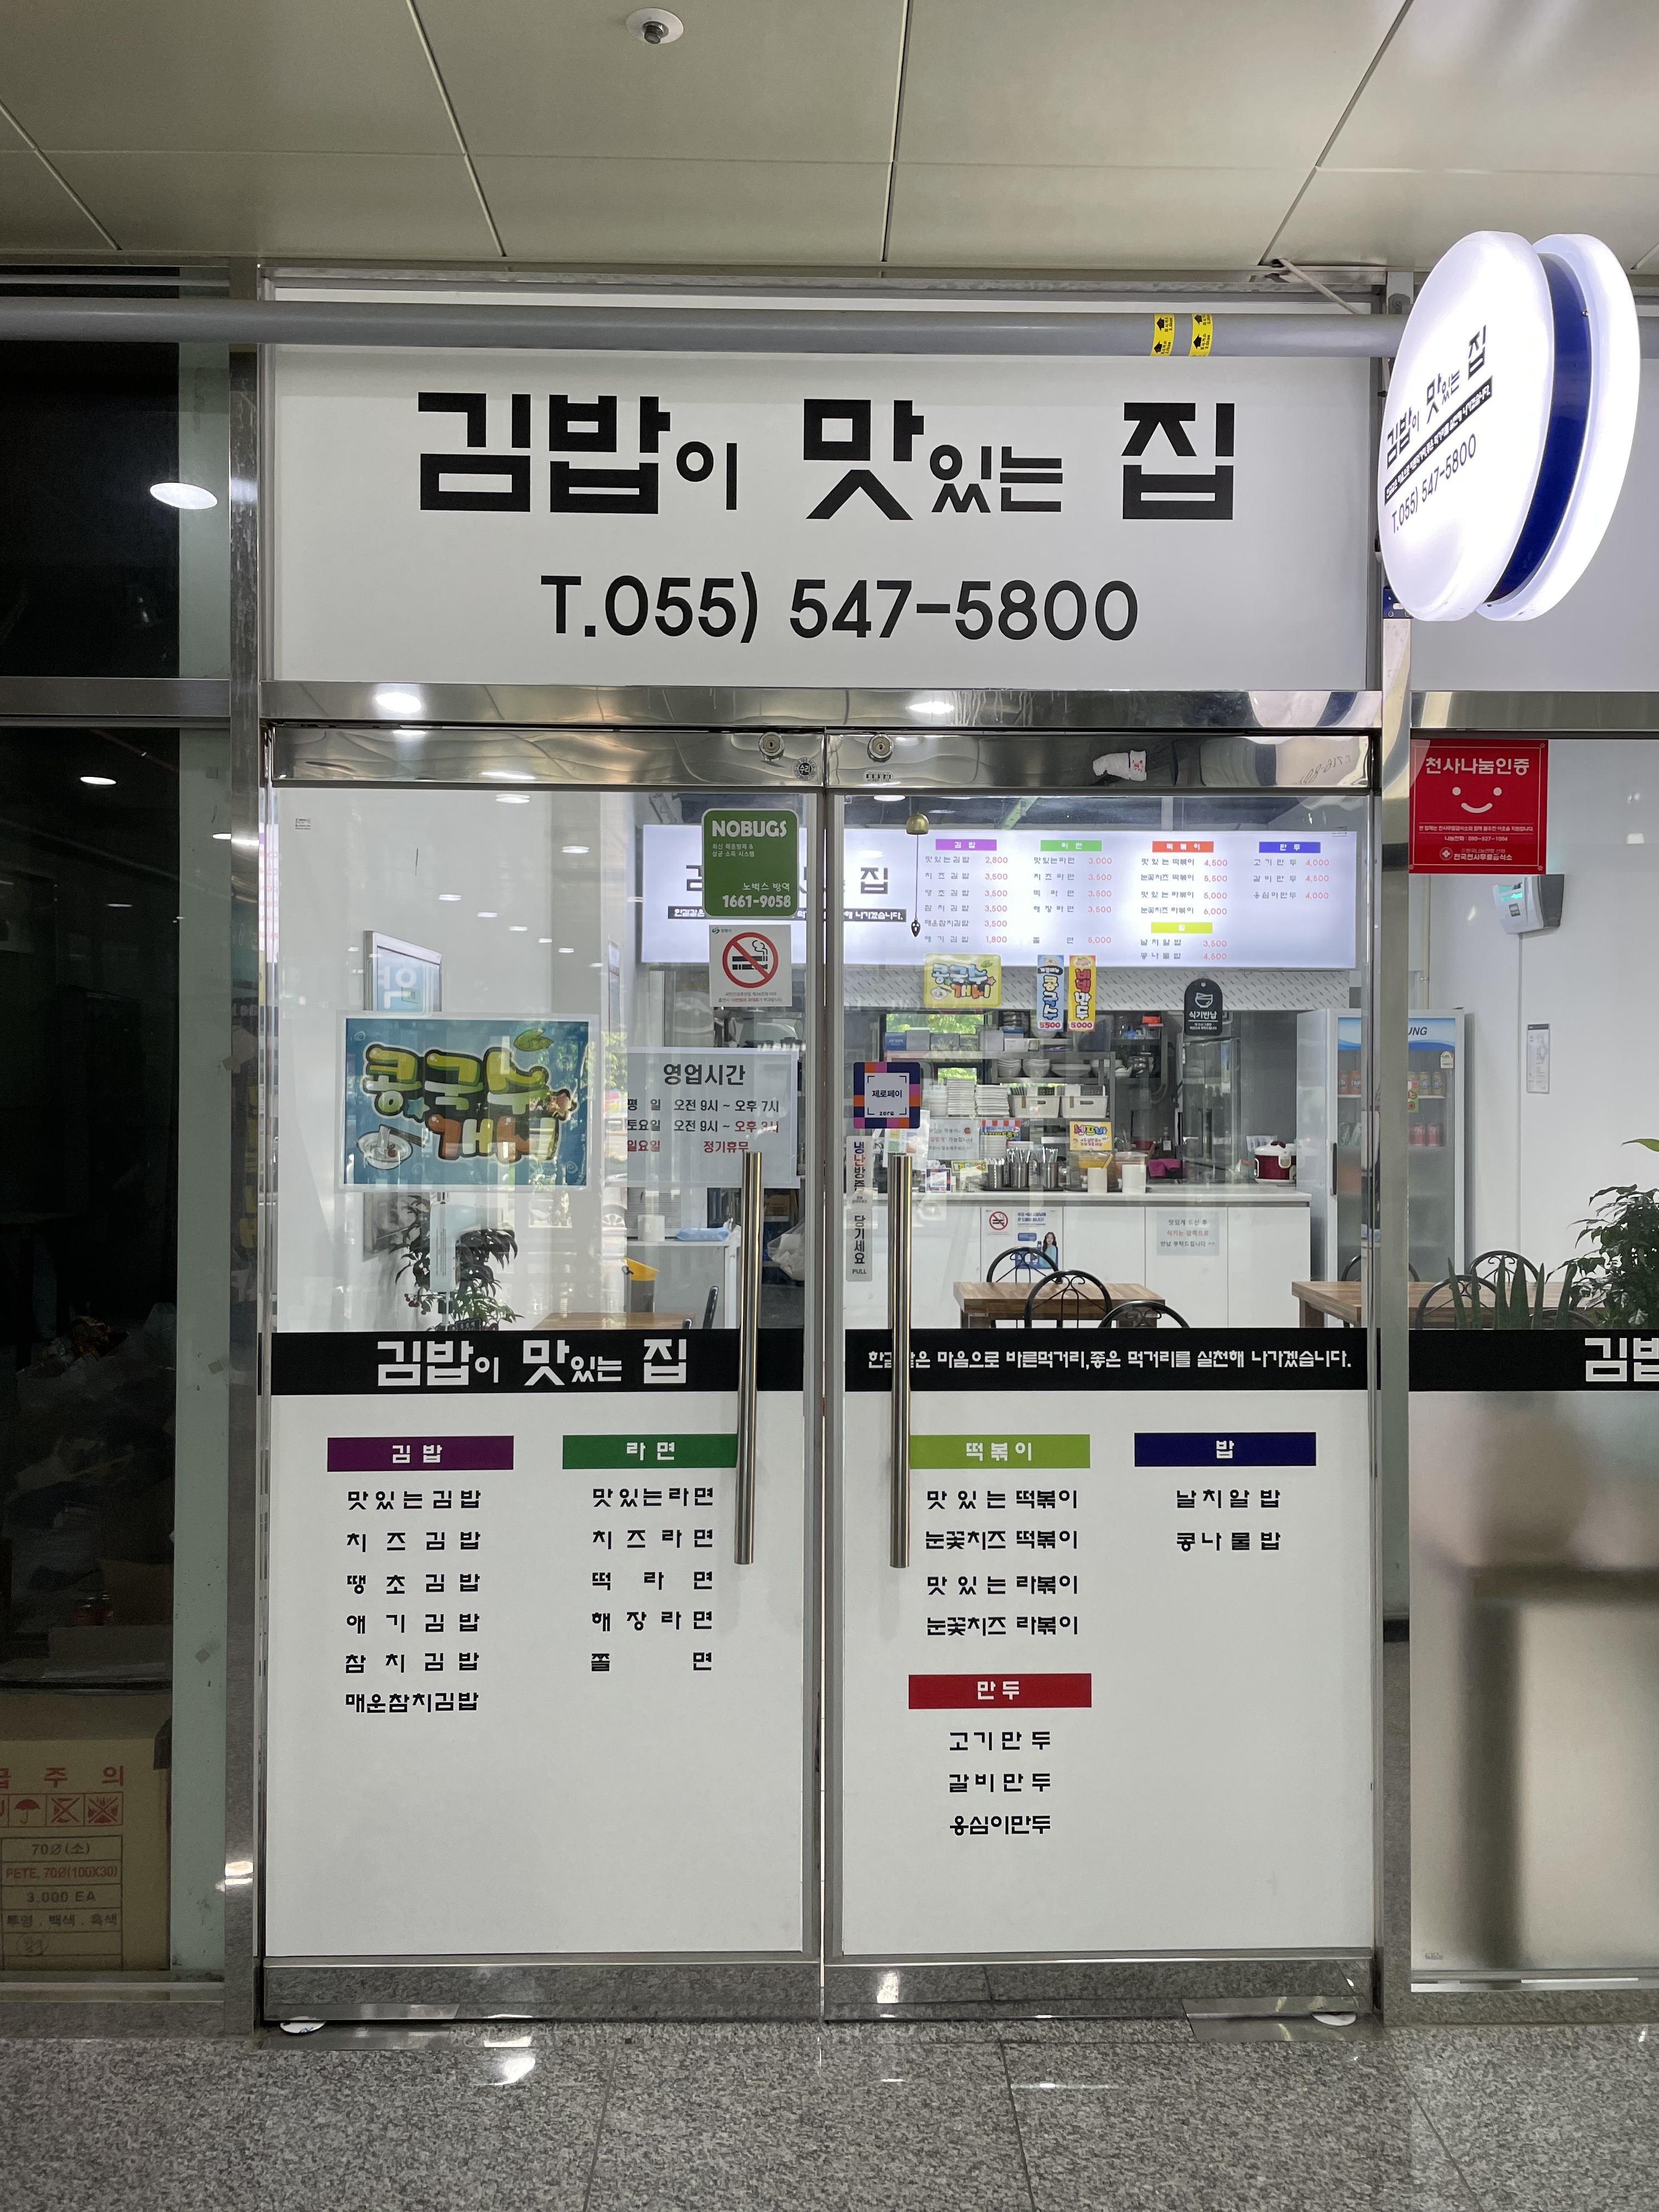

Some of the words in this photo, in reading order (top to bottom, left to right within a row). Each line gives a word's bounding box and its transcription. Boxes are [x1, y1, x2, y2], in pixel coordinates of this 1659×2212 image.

[1387, 407, 1419, 470] 김밥이
[1426, 370, 1459, 424] 맛있는
[1468, 325, 1486, 380] 집
[419, 392, 737, 514] 김밥이
[804, 399, 1063, 520] 맛있는
[1121, 402, 1235, 520] 집
[1392, 487, 1418, 533] T.055)
[1422, 433, 1476, 503] 547-5800
[541, 572, 758, 644] T.055)
[790, 579, 1138, 641] 547-5800
[1426, 757, 1530, 776] 천사나눔인증
[712, 821, 787, 837] NOBUGS
[743, 882, 769, 892] 노벅스
[772, 883, 790, 892] 방역
[860, 867, 889, 894] 집
[722, 895, 792, 908] 1661-9058
[1203, 940, 1227, 948] 3,500
[932, 963, 988, 985] 콩국수
[950, 984, 991, 999] 개시
[1042, 975, 1059, 1020] 콩국수
[1075, 968, 1092, 1020] 비빔만두
[1189, 1011, 1217, 1019] 식기반납
[363, 1043, 550, 1118] 콩국수
[663, 1063, 746, 1086] 영업시간
[872, 1090, 902, 1098] 제로페이
[674, 1099, 696, 1111] 오전
[700, 1099, 718, 1112] 9시
[735, 1100, 758, 1113] 오후
[761, 1100, 780, 1113] 7시
[627, 1120, 661, 1132] 토요일
[674, 1120, 696, 1132] 오전
[700, 1120, 718, 1132] 9시
[735, 1120, 757, 1133] 오후
[426, 1114, 558, 1161] 개시
[627, 1140, 661, 1152] 일요일
[703, 1141, 749, 1153] 정기휴무
[854, 1215, 866, 1265] 당기세요
[377, 1339, 499, 1387] 김밥이
[523, 1339, 622, 1386] 맛있는
[642, 1338, 687, 1384] 집
[937, 1351, 1000, 1369] 마음으로
[1128, 1351, 1190, 1368] 먹거리를
[1197, 1350, 1244, 1368] 실천해
[1252, 1350, 1352, 1368] 나가겠습니다.
[392, 1444, 443, 1464] 김밥
[626, 1441, 675, 1461] 라면
[1216, 1440, 1234, 1459] 밥
[1015, 1489, 1077, 1509] 떡볶이
[925, 1531, 1006, 1550] 눈꽃치즈
[1015, 1530, 1077, 1549] 떡볶이
[1016, 1575, 1077, 1595] 라볶이
[927, 1616, 1007, 1637] 눈꽃치즈
[1016, 1616, 1078, 1635] 라볶이
[977, 1681, 1020, 1701] 만두
[345, 1692, 479, 1713] 매운참치김밥
[949, 1815, 1051, 1836] 옹심이만두
[75, 1892, 96, 1903] EA
